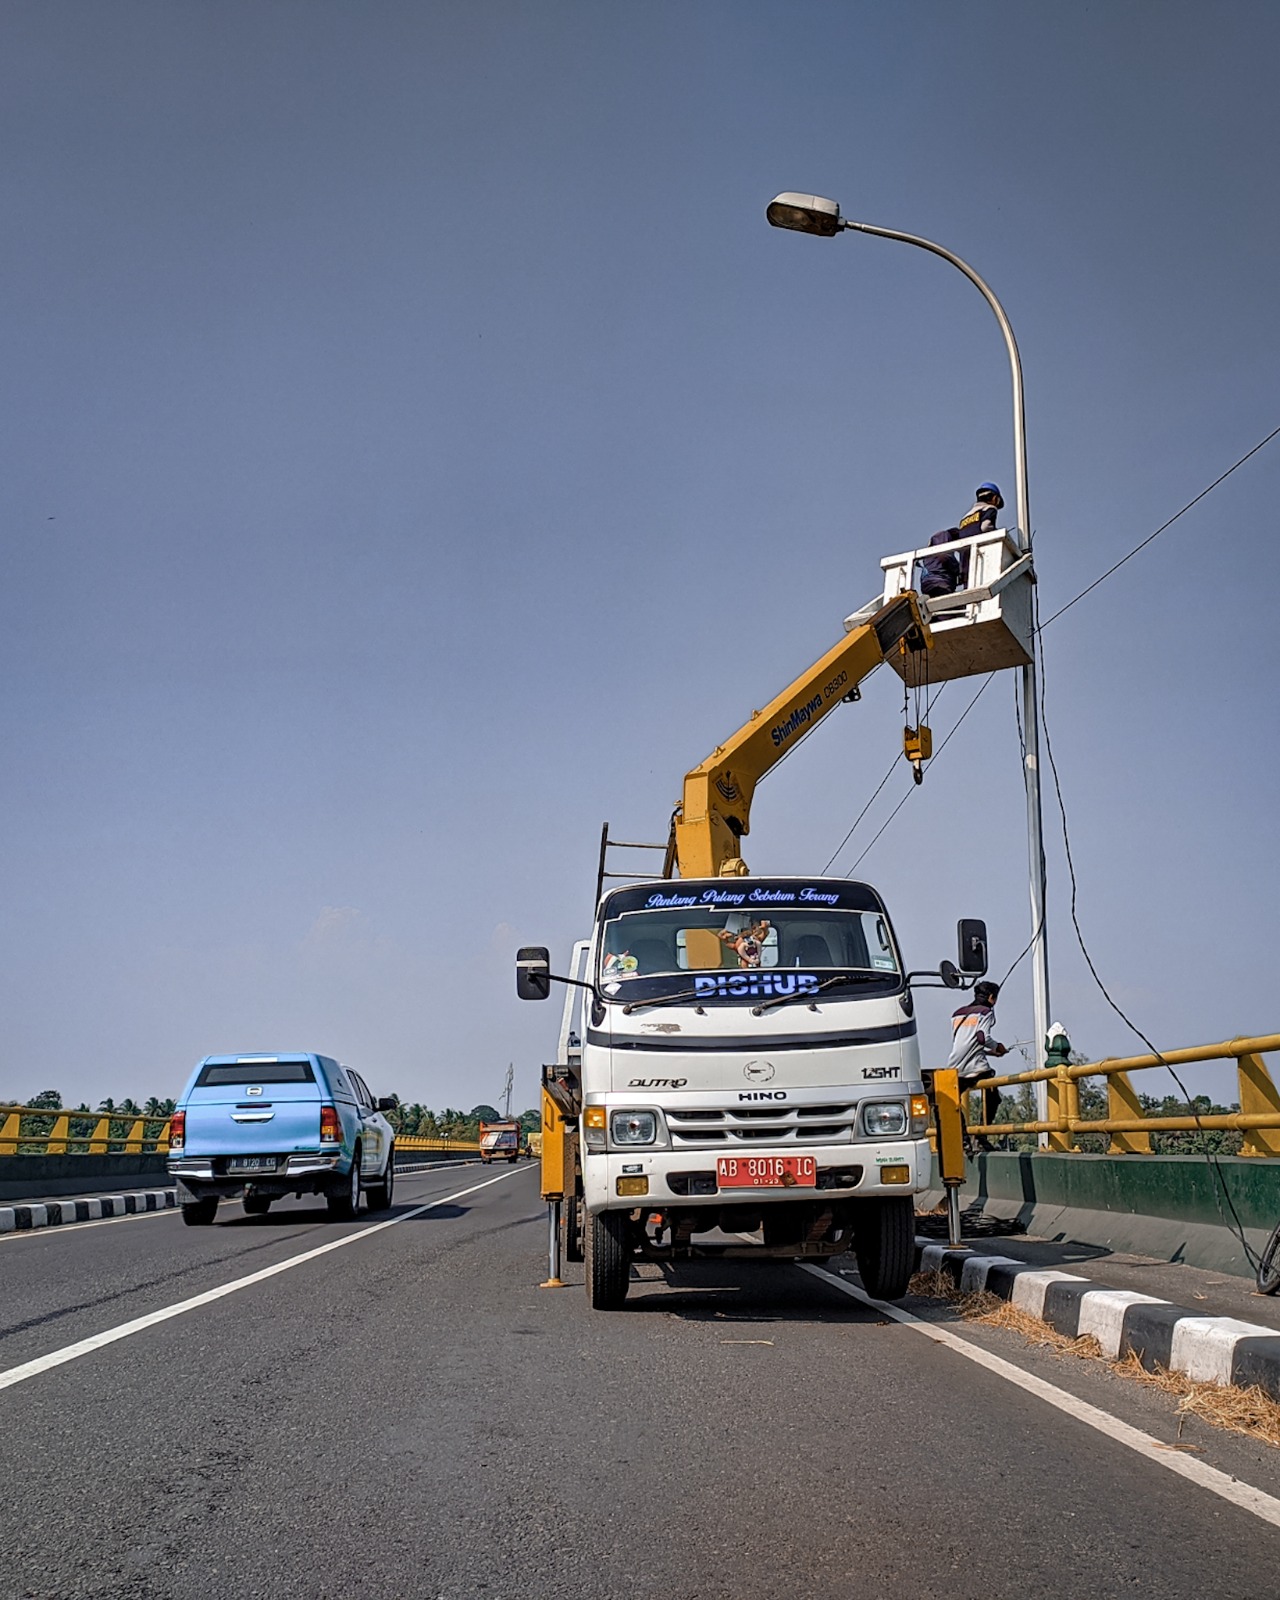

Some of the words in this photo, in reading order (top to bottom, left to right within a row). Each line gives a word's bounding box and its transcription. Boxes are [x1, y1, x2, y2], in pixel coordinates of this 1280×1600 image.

[771, 693, 823, 747] ShinMaywa
[644, 893, 698, 908] Pantang
[700, 888, 746, 906] Pulang
[749, 887, 796, 902] Sebelum
[798, 887, 840, 905] Terang
[694, 974, 820, 997] DISHUB
[627, 1078, 688, 1089] DUTRO
[738, 1091, 787, 1101] HINO
[719, 1159, 738, 1177] AB
[748, 1158, 785, 1177] 8016
[796, 1158, 813, 1176] IC
